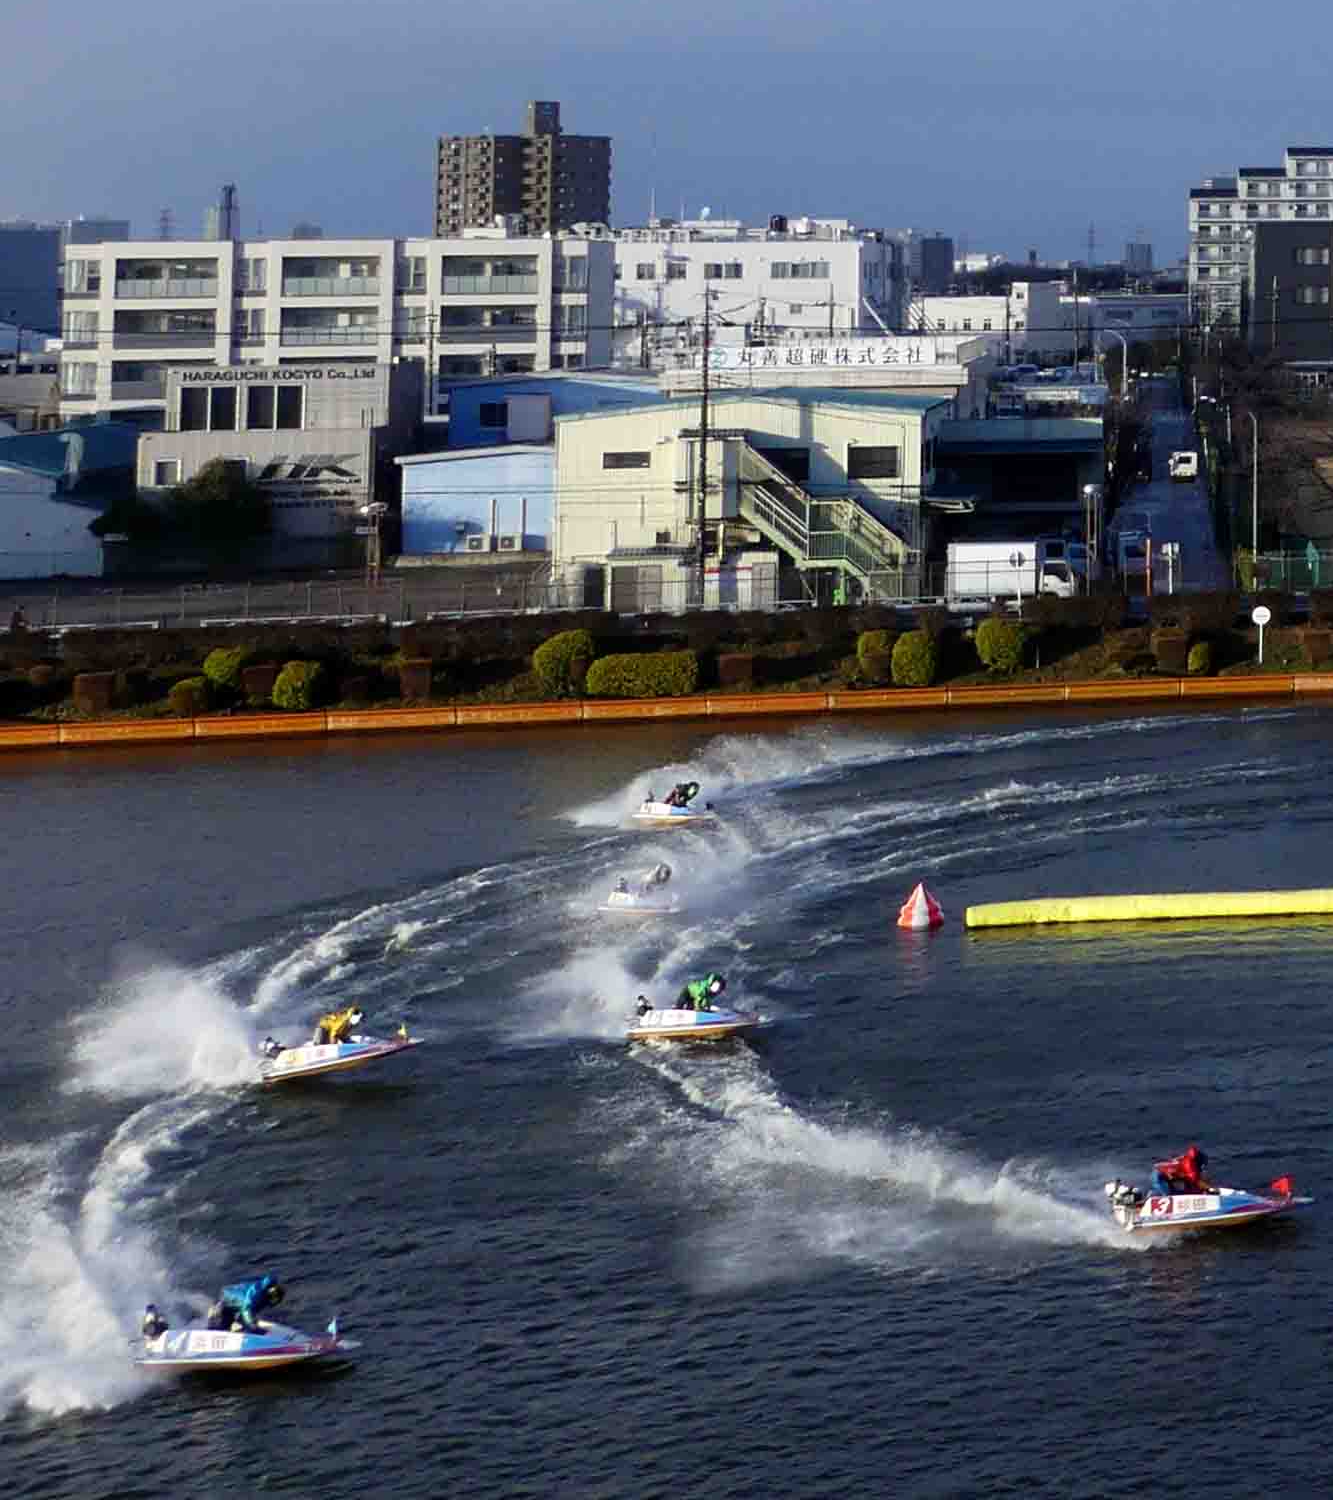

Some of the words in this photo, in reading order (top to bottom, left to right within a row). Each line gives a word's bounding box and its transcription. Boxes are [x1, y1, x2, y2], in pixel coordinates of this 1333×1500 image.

[182, 369, 269, 382] HARAGUCHI
[272, 368, 323, 381] KOGYO
[1158, 1197, 1171, 1216] 3
